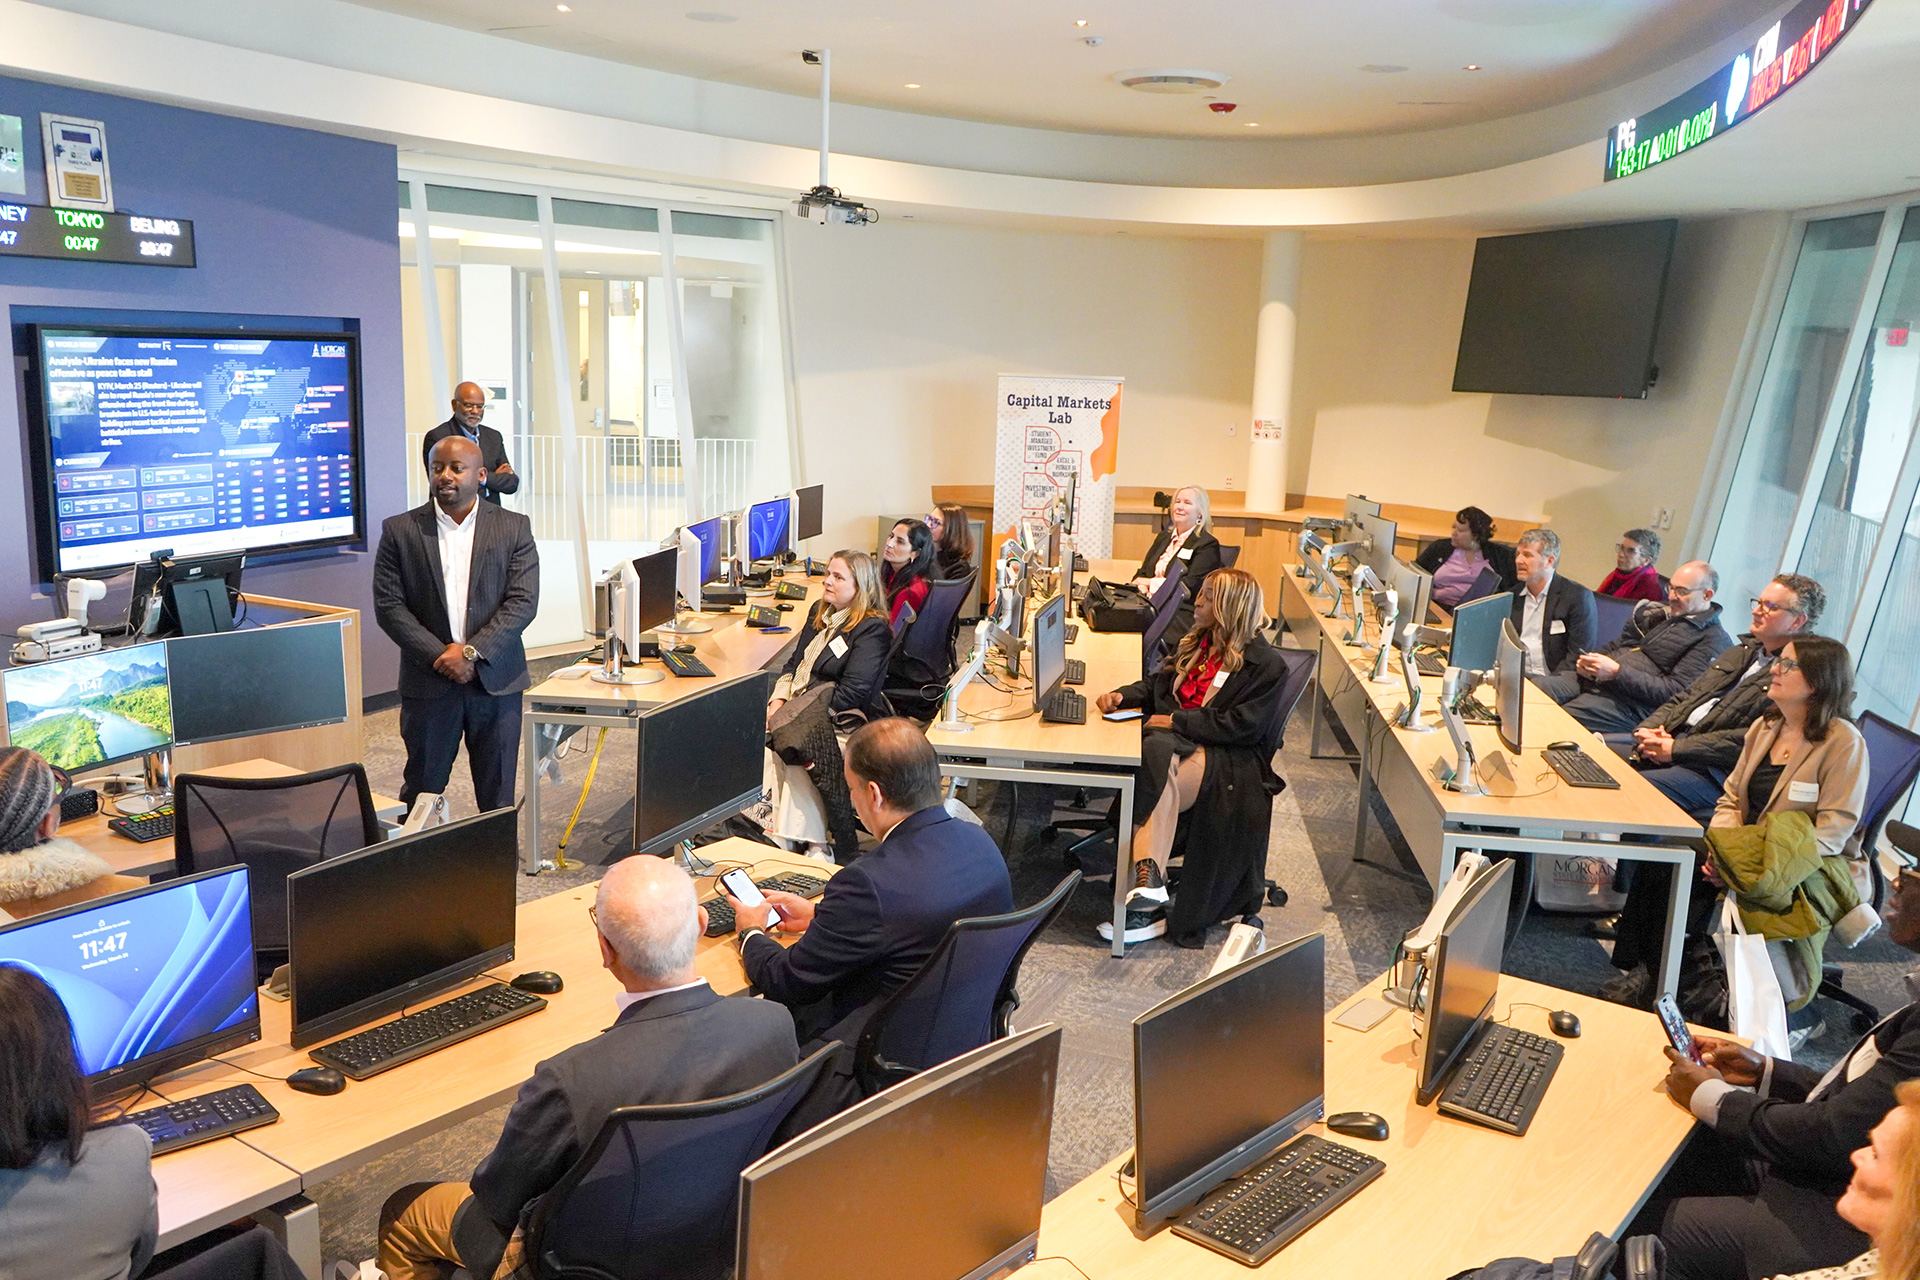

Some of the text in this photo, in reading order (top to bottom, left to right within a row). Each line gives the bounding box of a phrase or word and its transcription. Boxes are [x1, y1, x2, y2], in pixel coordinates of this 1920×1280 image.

[1617, 118, 1637, 152] PG
[55, 210, 105, 229] TOKYO
[321, 345, 345, 353] MORGAN
[49, 356, 178, 367] Analysis-Ukraine faces new Russian
[50, 368, 153, 379] offensive as peace talks stall
[114, 382, 133, 390] March
[1007, 394, 1112, 410] Capital Markets
[1048, 412, 1072, 424] Lab
[1255, 420, 1262, 430] NO
[78, 677, 103, 692] 11:47
[79, 932, 127, 960] 11:47
